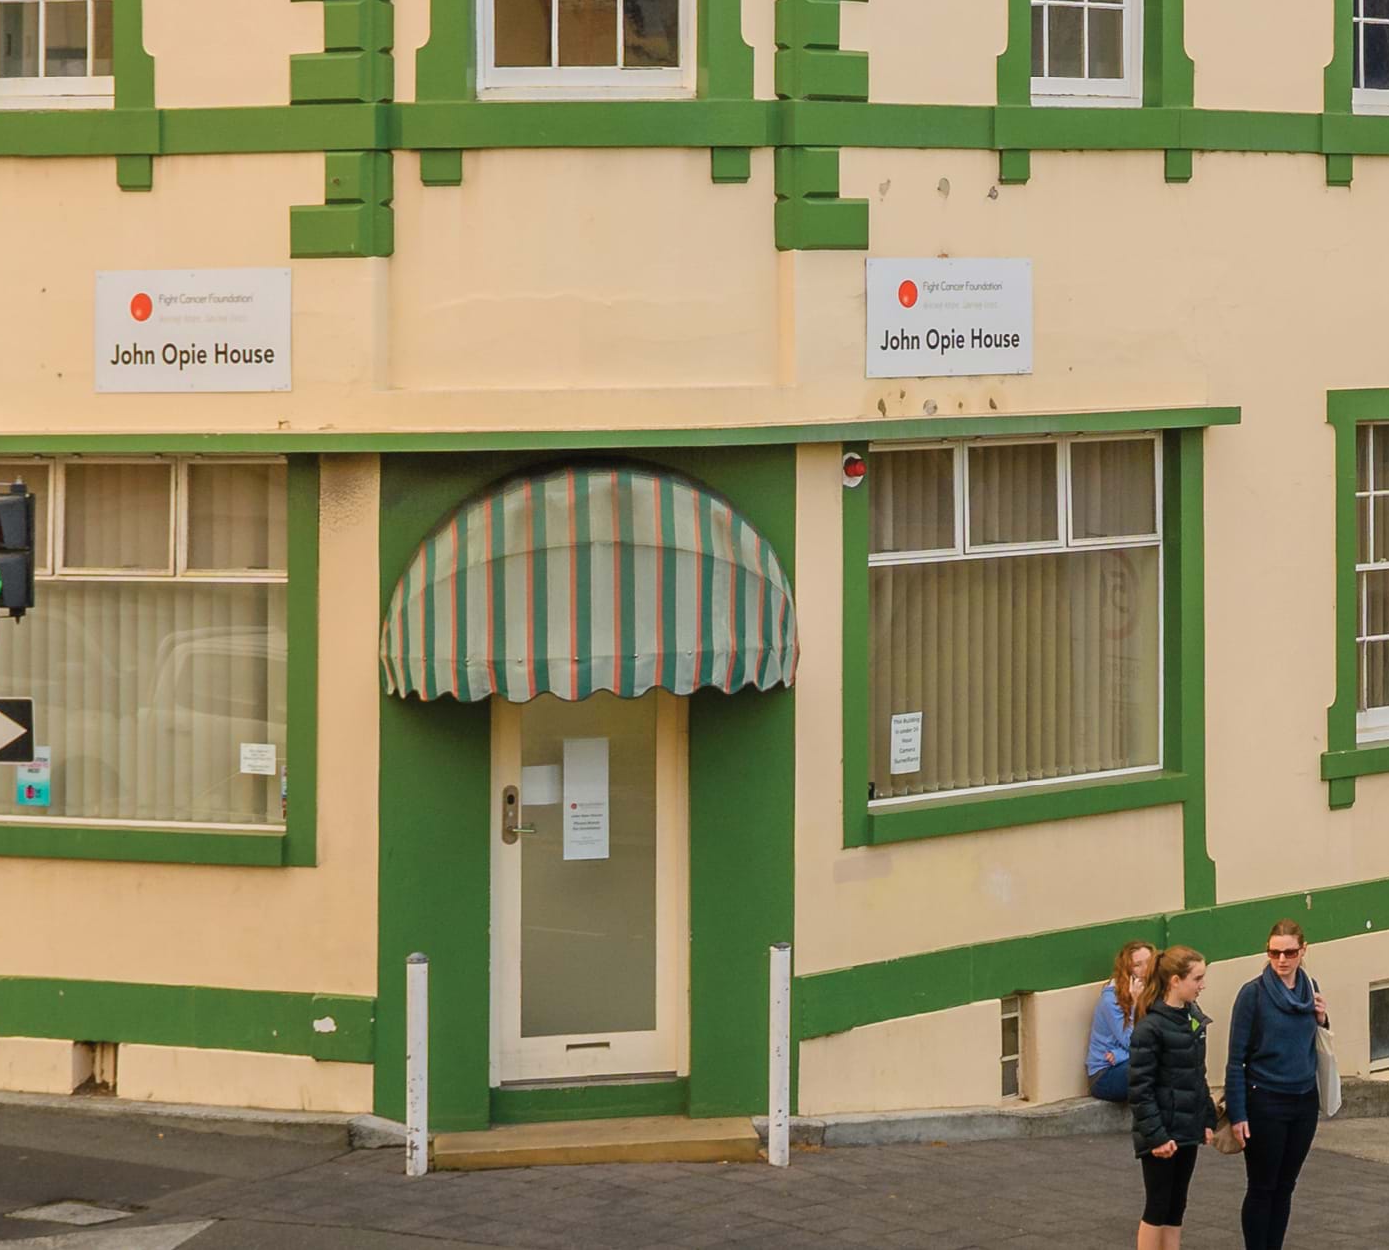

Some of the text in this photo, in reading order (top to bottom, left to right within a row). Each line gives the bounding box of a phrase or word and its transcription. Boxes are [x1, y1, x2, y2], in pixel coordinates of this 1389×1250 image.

[880, 328, 1020, 355] John Opie House
[110, 343, 275, 370] John Opie House
